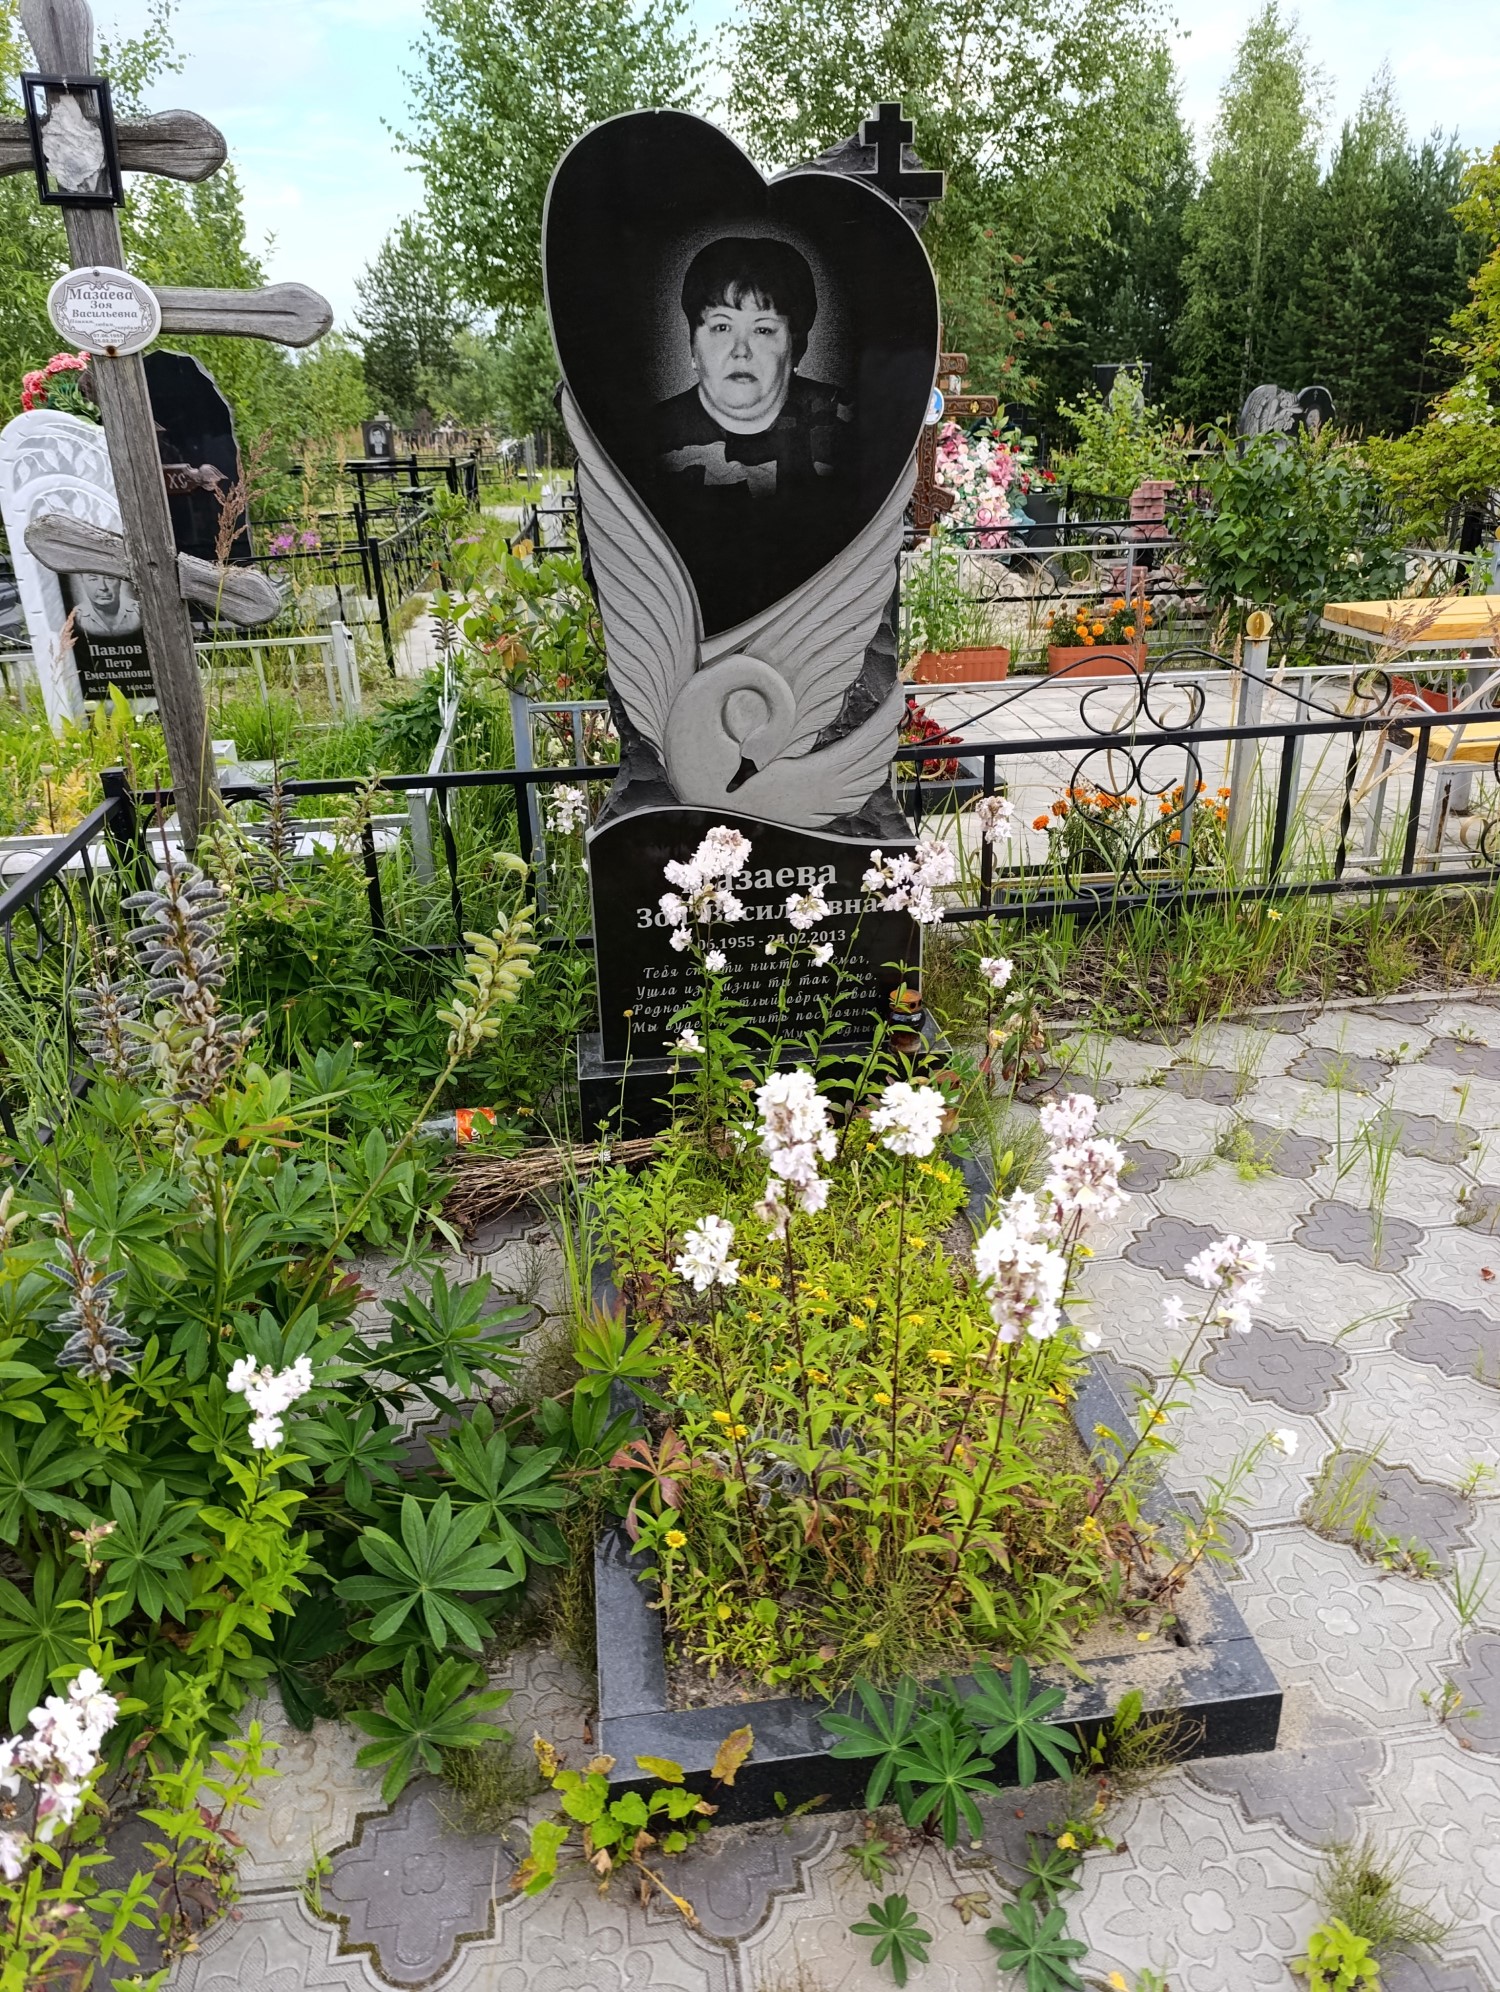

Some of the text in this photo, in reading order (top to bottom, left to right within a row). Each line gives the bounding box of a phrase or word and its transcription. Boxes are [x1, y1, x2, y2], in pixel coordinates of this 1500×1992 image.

[69, 288, 133, 300] Мазаева
[90, 300, 113, 309] Зоя
[72, 309, 138, 318] Васильевна
[88, 644, 143, 657] Павлов
[104, 658, 133, 670] Петр
[83, 669, 153, 681] Емельянови
[88, 683, 155, 693] 06.12.7 14.04.201
[698, 896, 879, 924] Всилвна
[682, 935, 756, 951] 06.1955
[643, 964, 679, 979] Тебя
[685, 961, 744, 977] спти
[750, 957, 801, 972] никто
[635, 985, 678, 1000] Ушла
[684, 984, 702, 998] из
[709, 980, 761, 994] изни
[768, 976, 792, 989] ты
[799, 973, 830, 986] так
[631, 1021, 659, 1034] Мы
[719, 1011, 789, 1028] нить
